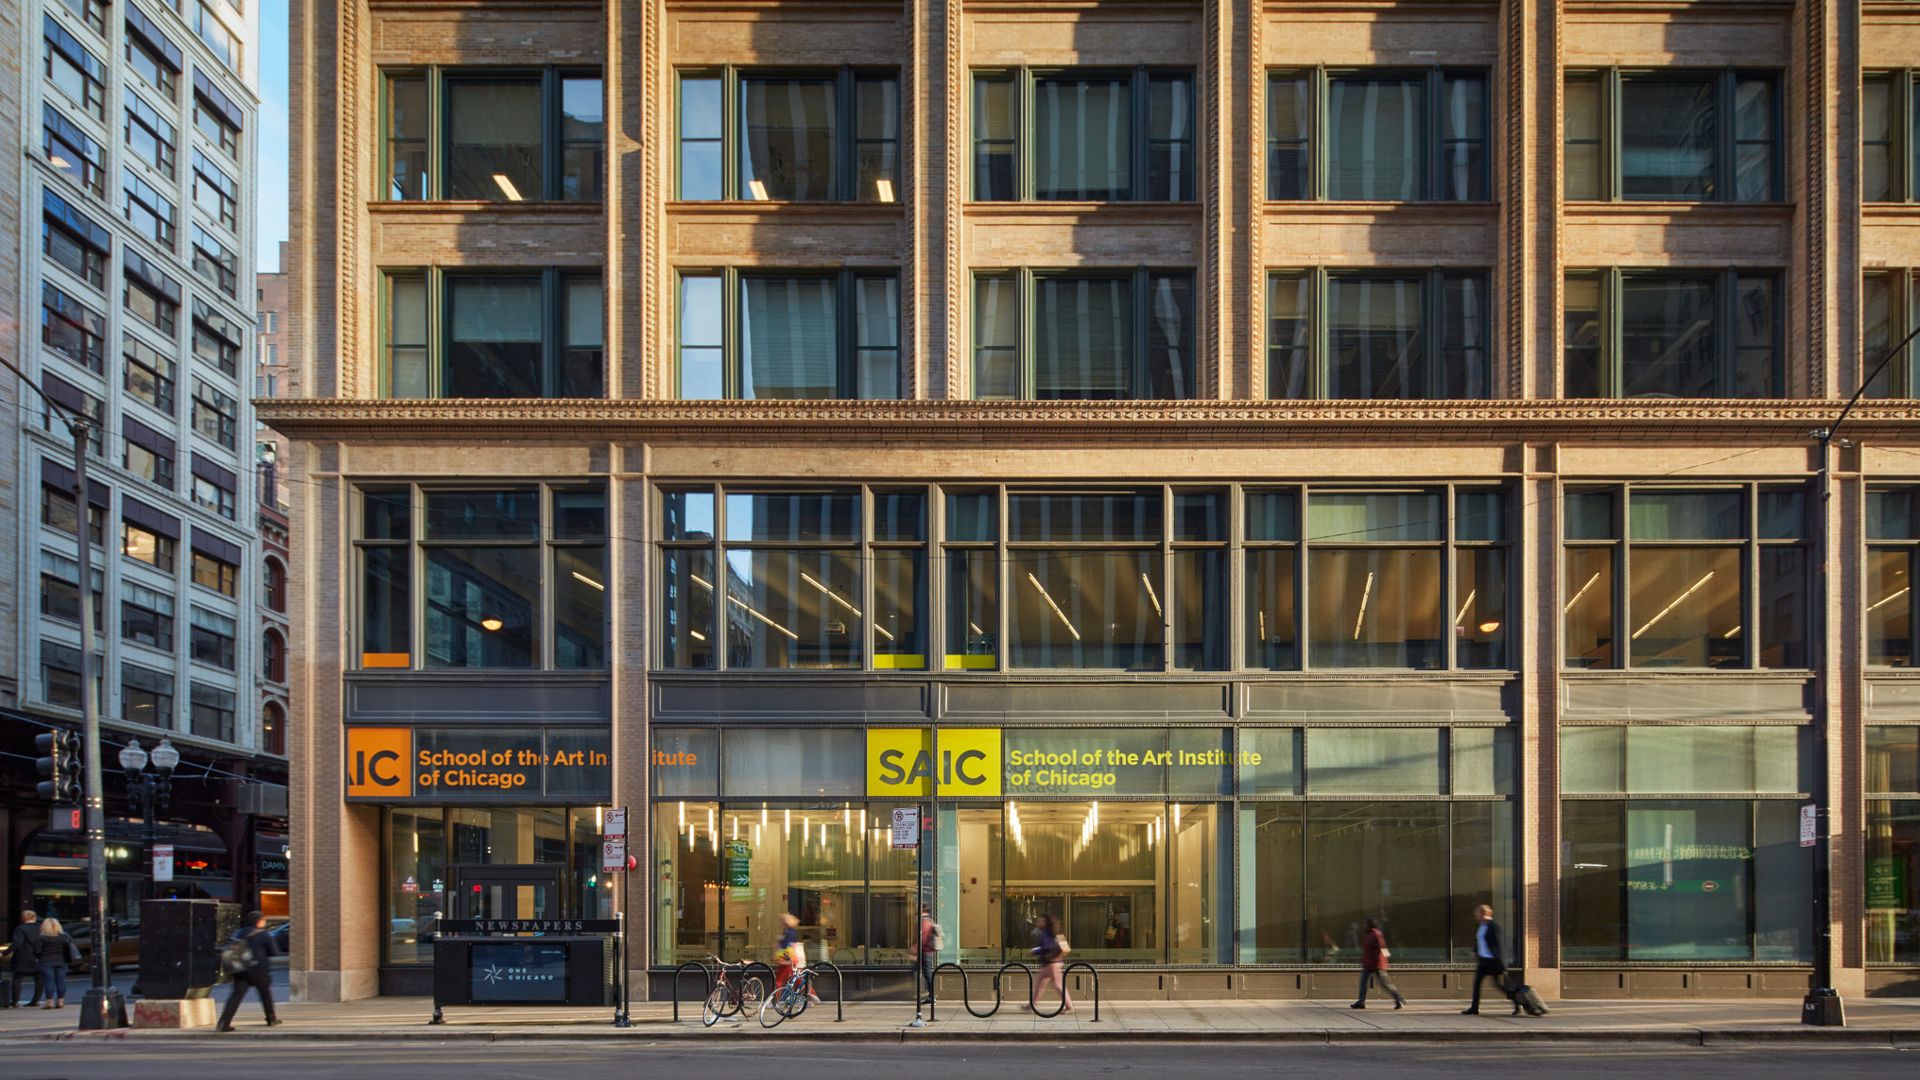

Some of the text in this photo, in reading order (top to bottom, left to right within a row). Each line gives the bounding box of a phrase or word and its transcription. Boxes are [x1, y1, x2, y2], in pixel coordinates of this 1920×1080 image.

[419, 749, 487, 766] School
[491, 749, 513, 766] of
[517, 749, 549, 766] the
[553, 750, 584, 766] Art
[878, 749, 987, 786] SAIC
[1010, 749, 1077, 766] School
[1081, 749, 1103, 766] of
[1106, 749, 1139, 766] the
[1142, 749, 1173, 766] Art
[348, 749, 400, 787] IC
[419, 769, 526, 789] of Chicago
[1010, 769, 1117, 789] of Chicago
[475, 921, 583, 931] NEWSPAPERS
